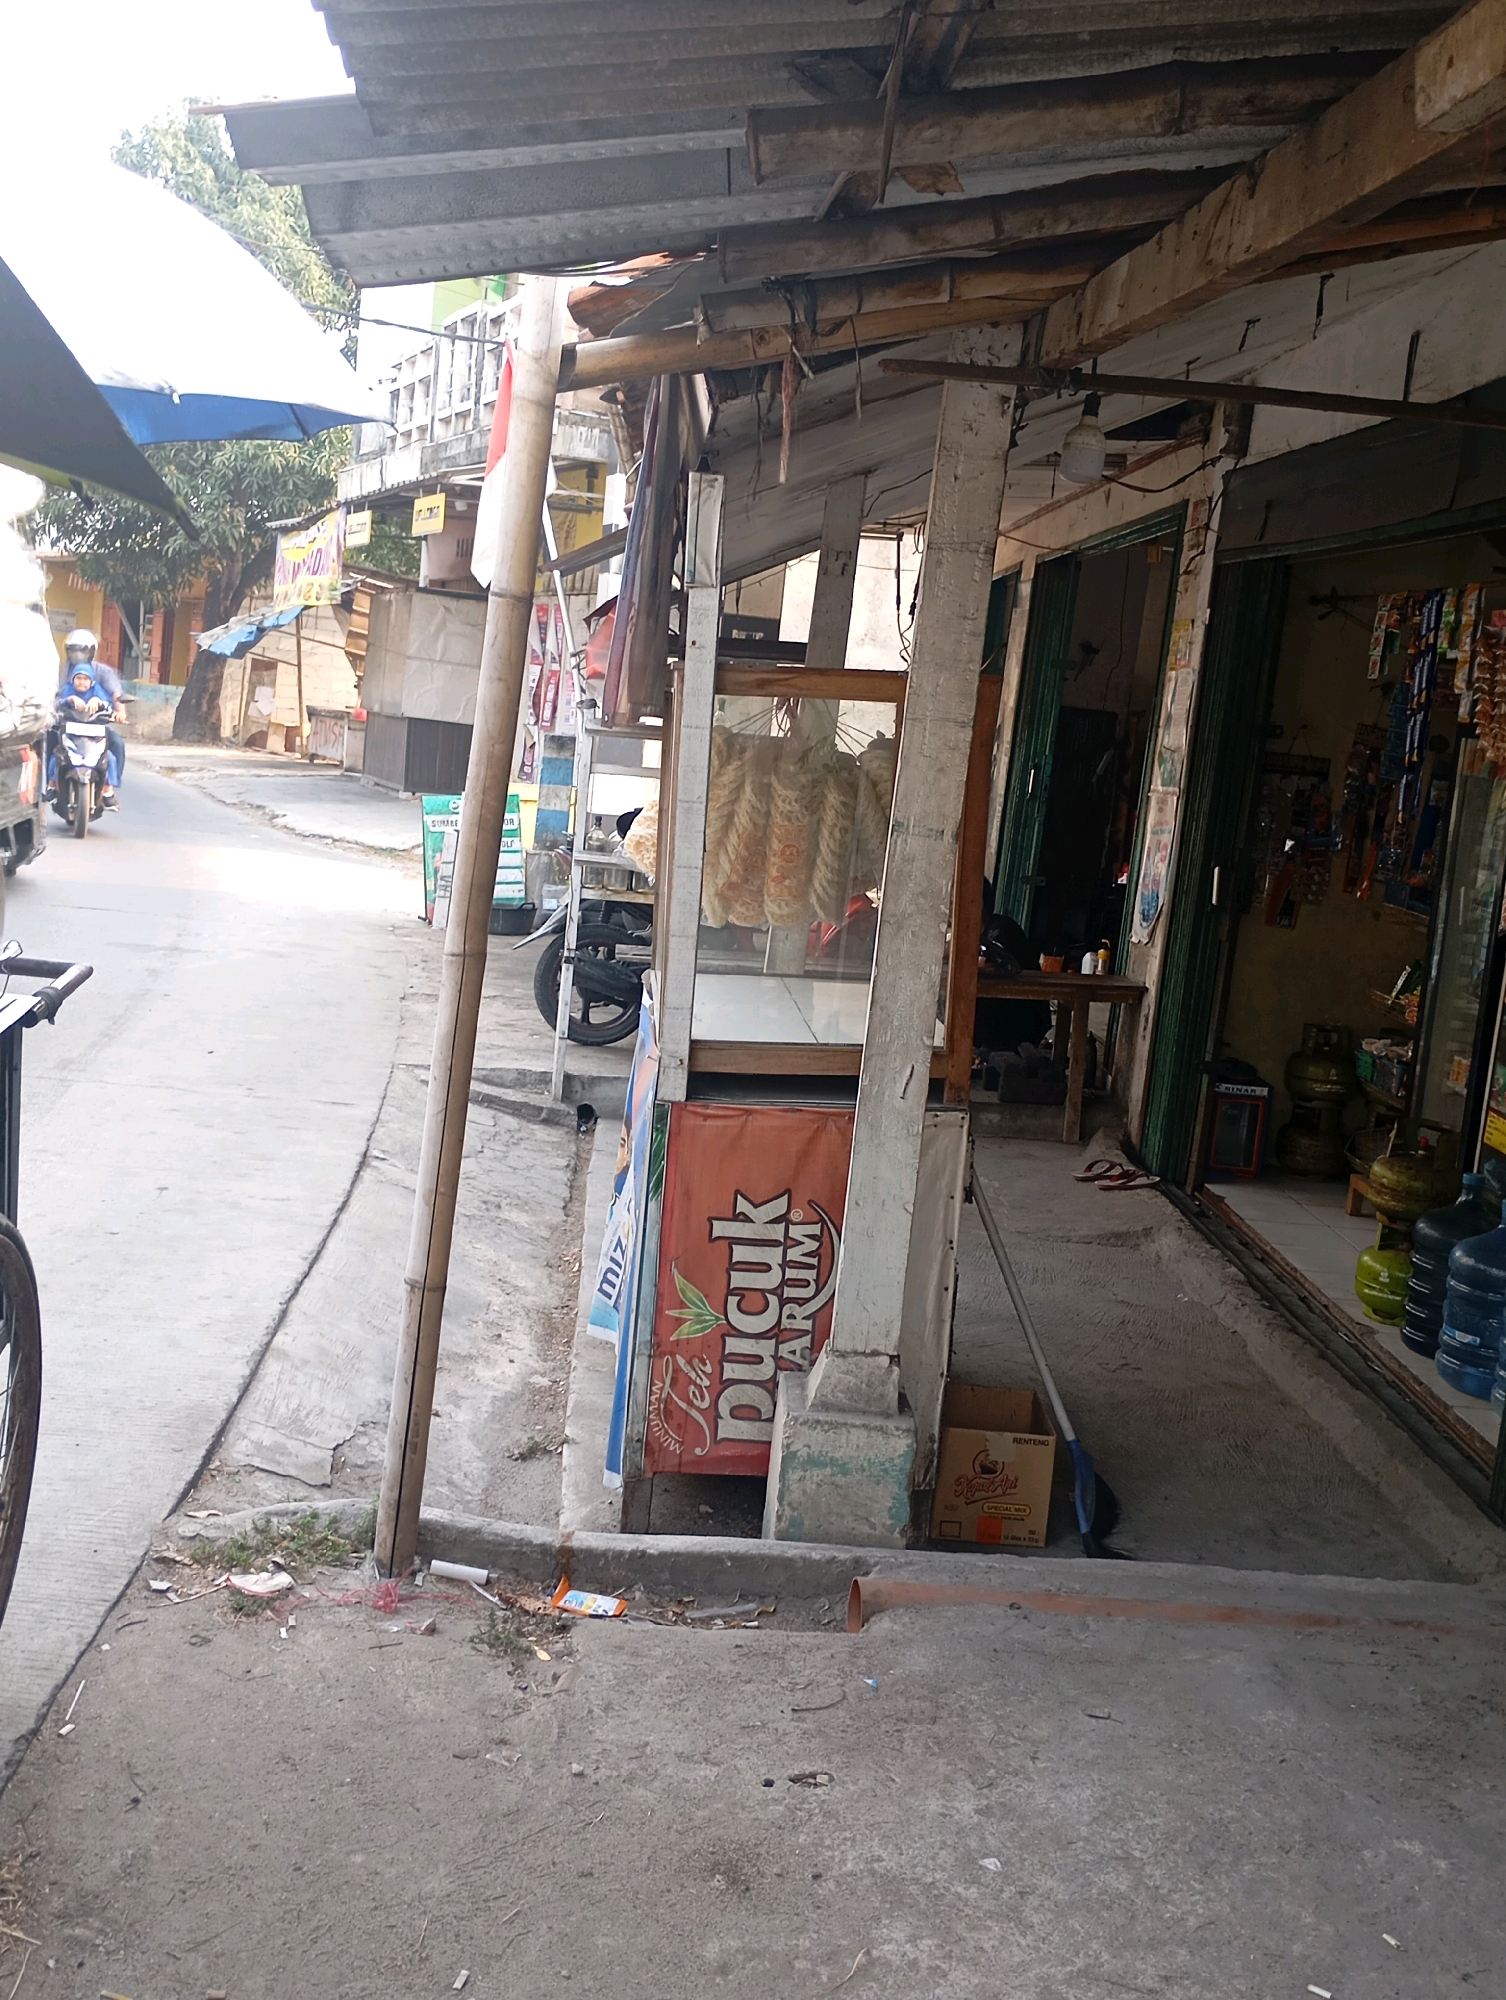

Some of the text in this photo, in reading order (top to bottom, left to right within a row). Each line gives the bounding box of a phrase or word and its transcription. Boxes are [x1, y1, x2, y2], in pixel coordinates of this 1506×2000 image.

[431, 818, 515, 828] SUMBE OR
[708, 1189, 791, 1444] pucuk
[778, 1222, 825, 1374] ARUM
[649, 1380, 684, 1454] MINUMAN
[661, 1354, 713, 1456] Teh
[1012, 1437, 1050, 1447] RENTENG
[954, 1474, 1019, 1499] Kapal Api
[985, 1504, 1028, 1514] SPECIAL MIX
